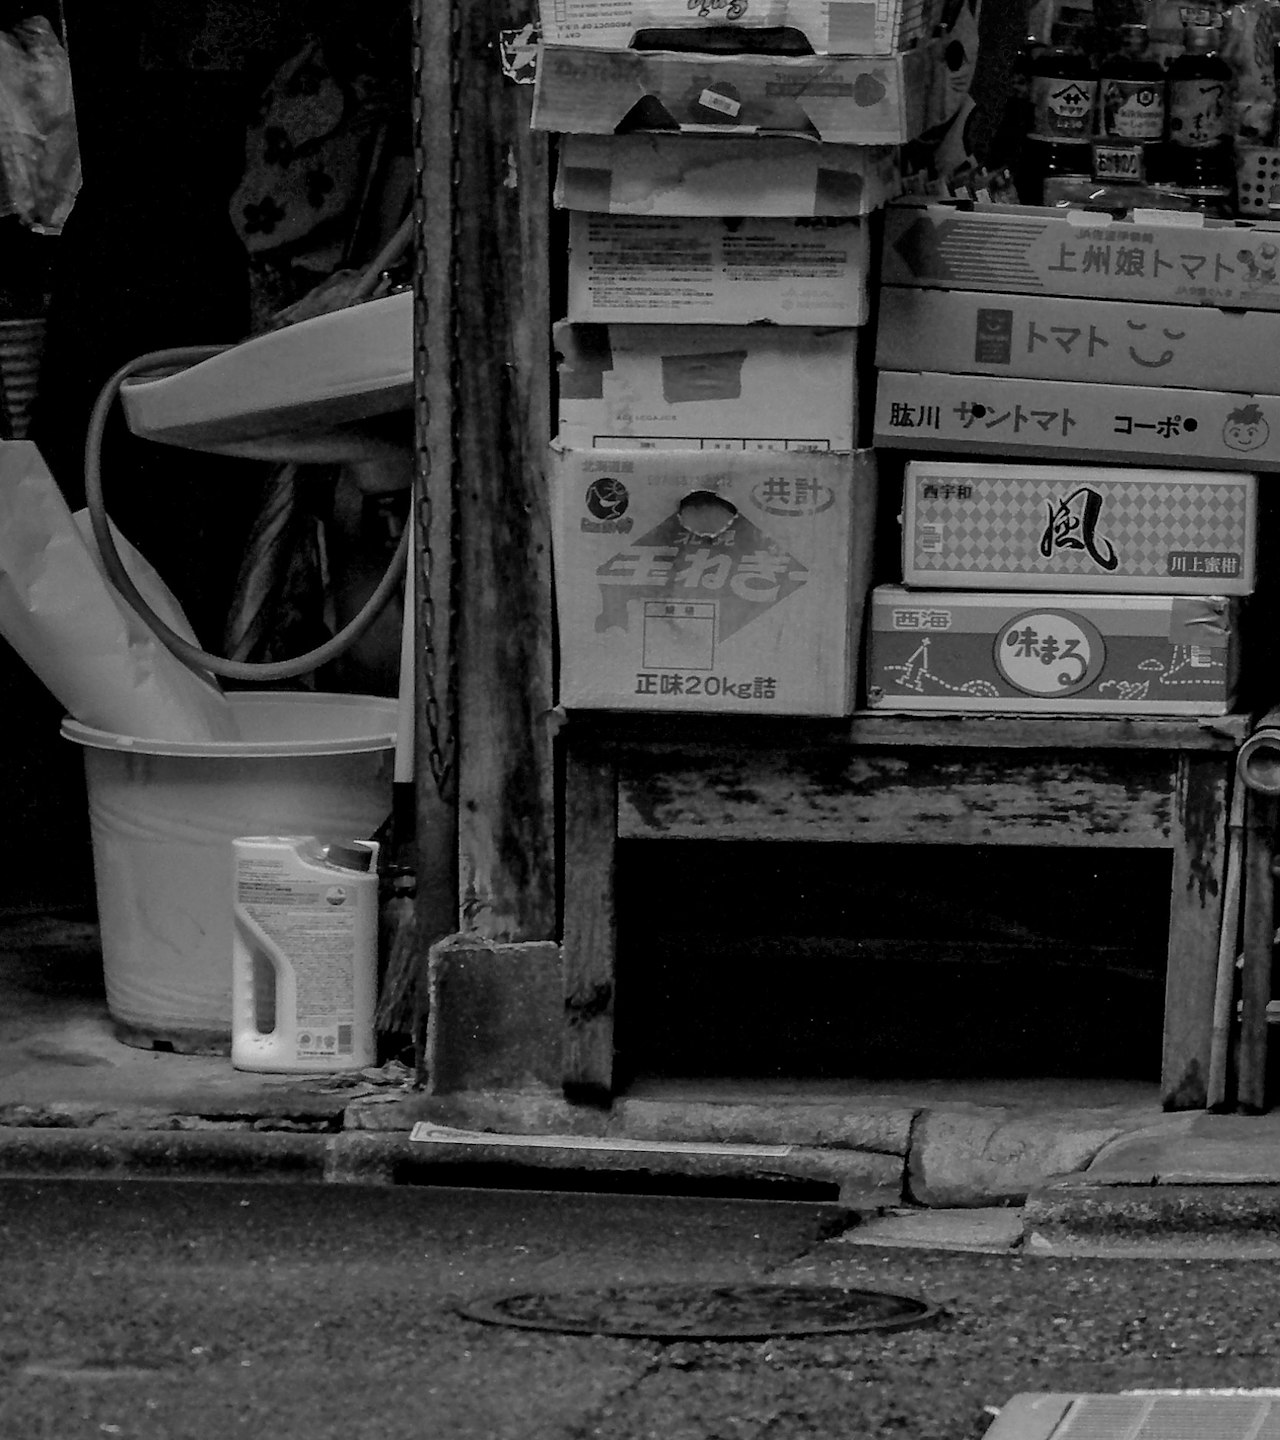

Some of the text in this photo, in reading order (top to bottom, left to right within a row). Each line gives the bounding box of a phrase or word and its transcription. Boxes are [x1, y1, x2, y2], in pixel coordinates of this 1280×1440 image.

[1048, 242, 1235, 282] 上州娘トマト
[1028, 320, 1109, 358] トマト
[889, 402, 941, 429] 肱川
[762, 476, 823, 505] 共計
[1170, 555, 1237, 574] 川上蜜柑
[892, 609, 951, 630] 西海
[1007, 626, 1088, 686] 味まろ
[634, 673, 777, 700] 正味20kg詰
